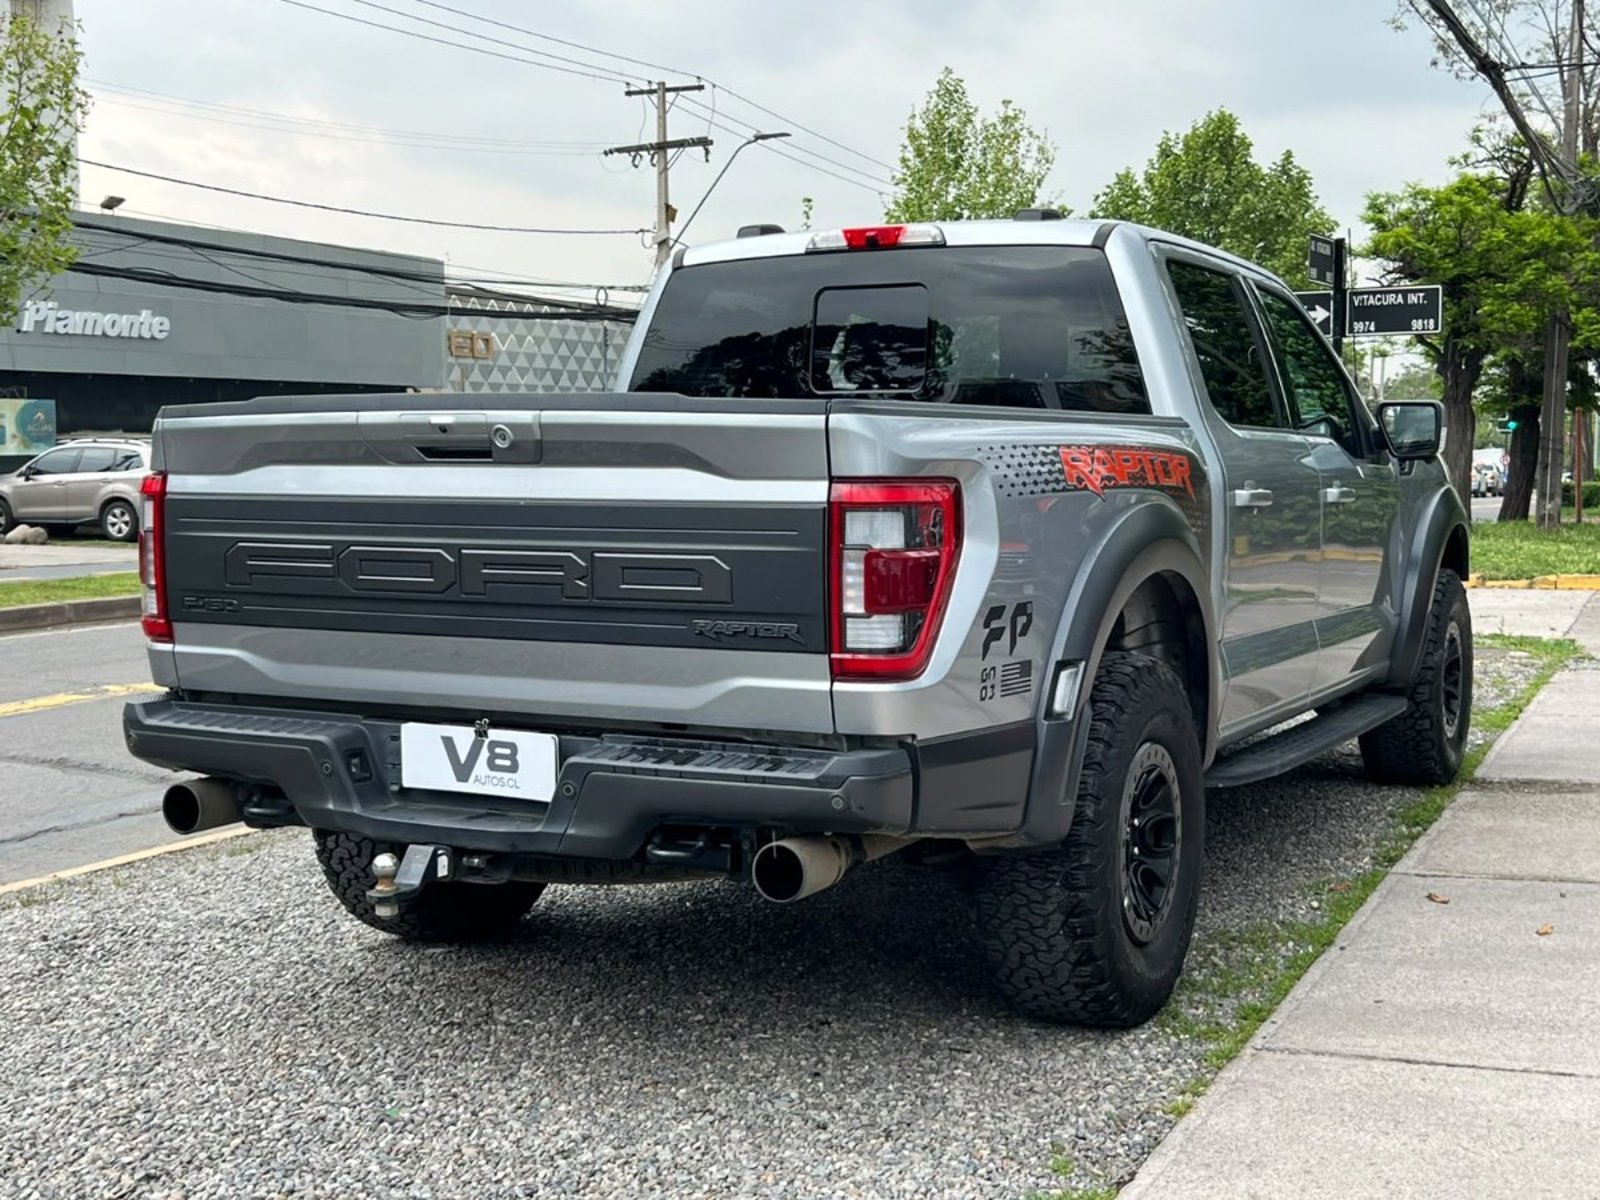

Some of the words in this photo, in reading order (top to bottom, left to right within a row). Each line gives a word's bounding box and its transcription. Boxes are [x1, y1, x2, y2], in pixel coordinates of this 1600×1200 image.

[1352, 292, 1404, 307] VITACURA
[1407, 292, 1428, 305] INT.
[21, 300, 170, 339] Piamonte
[1059, 446, 1196, 502] RAPTOR
[225, 541, 733, 606] FORD
[691, 618, 808, 646] RAPTOR
[440, 735, 520, 783] V8
[473, 774, 520, 789] AUTOS.CL
